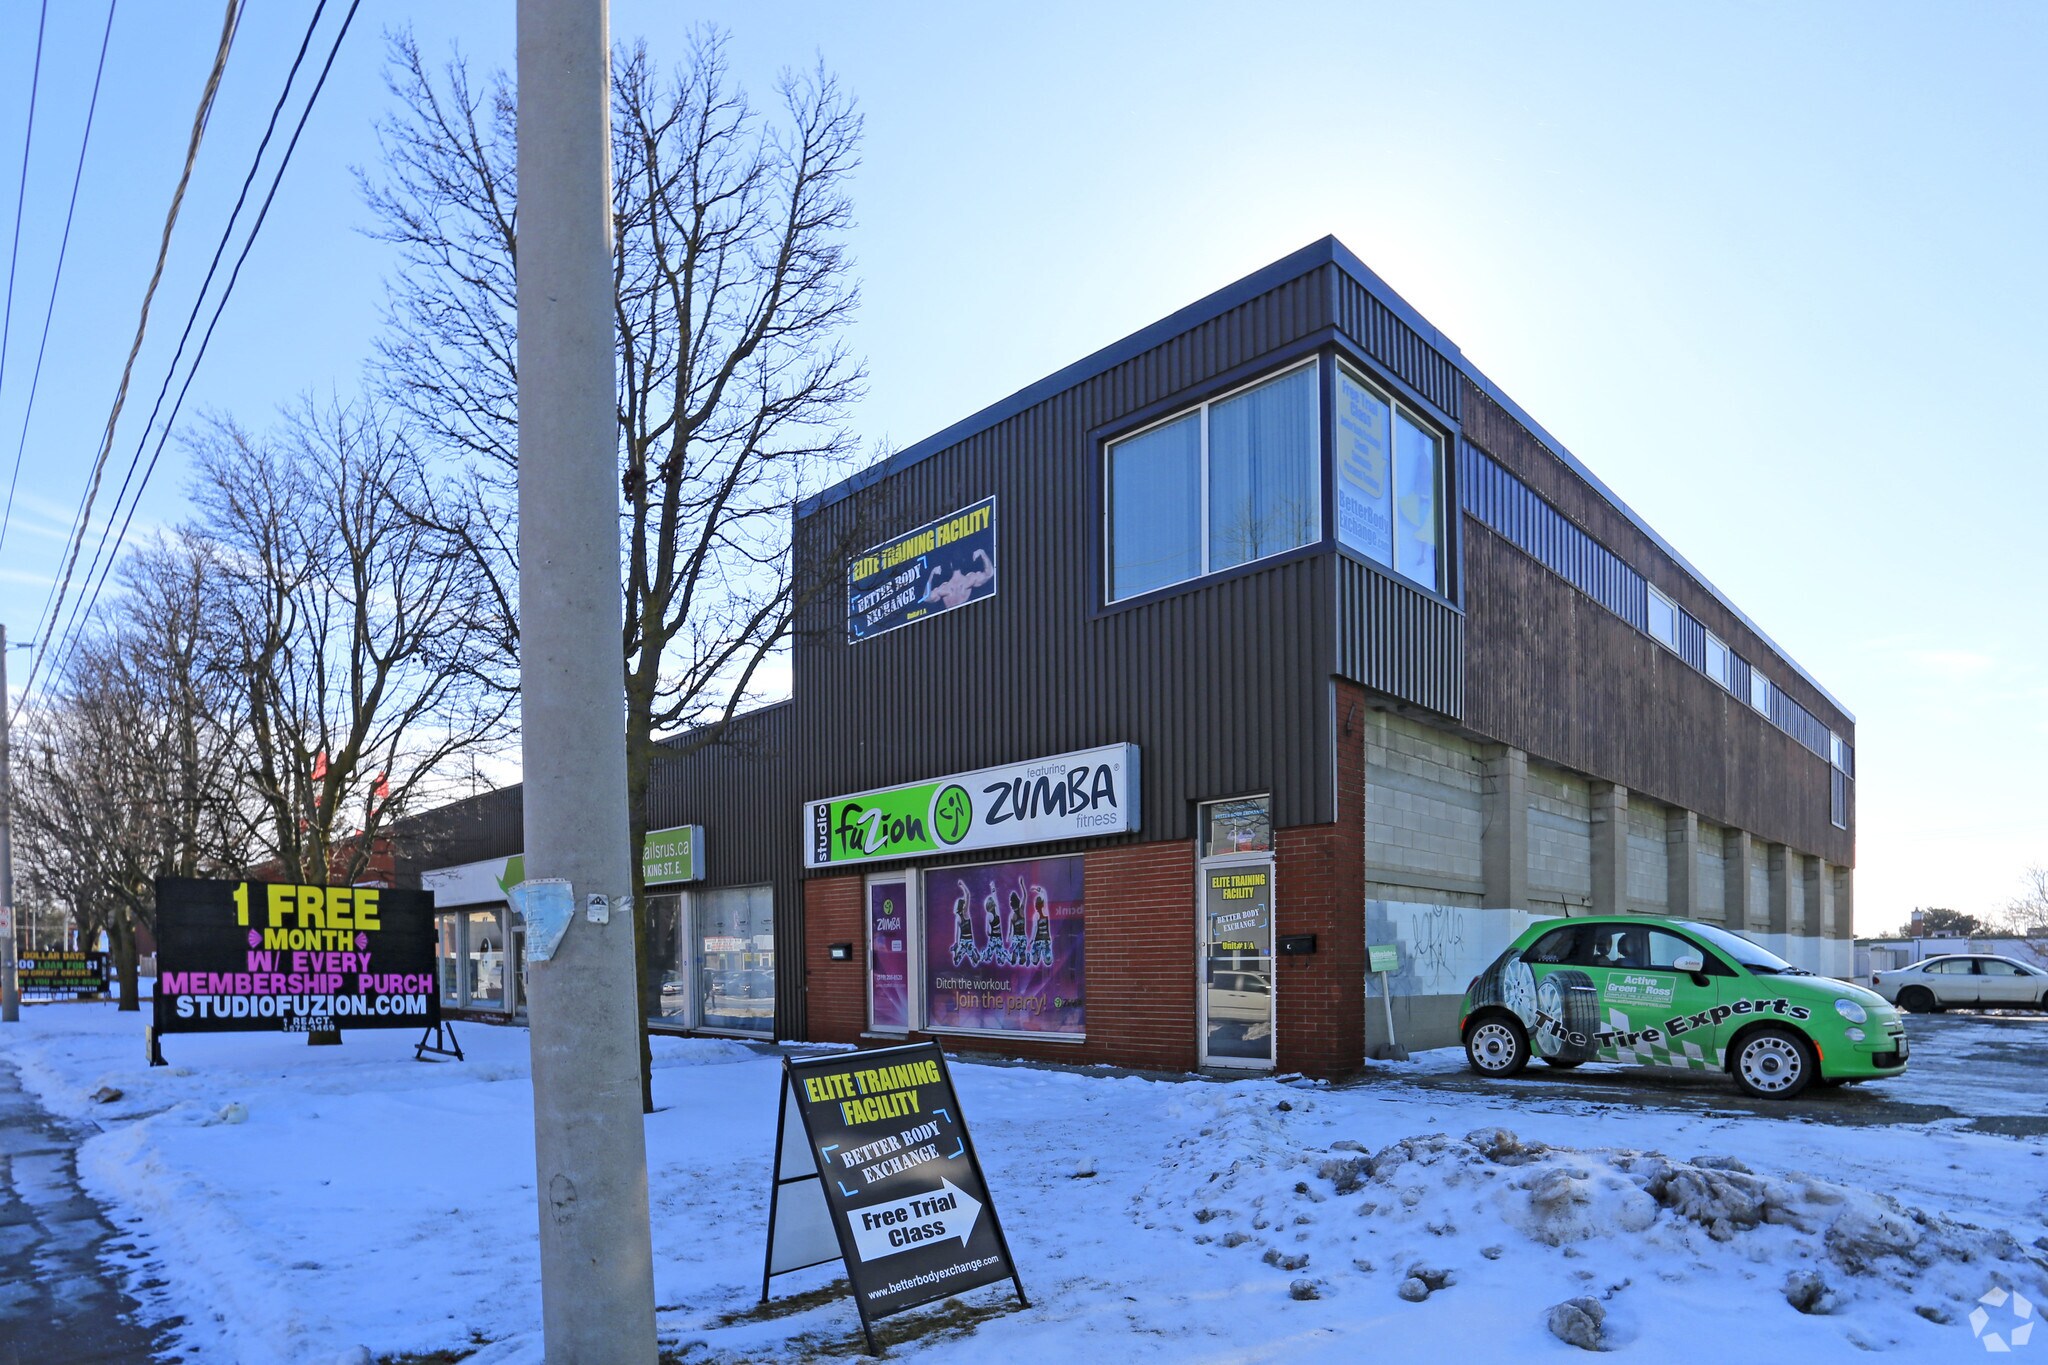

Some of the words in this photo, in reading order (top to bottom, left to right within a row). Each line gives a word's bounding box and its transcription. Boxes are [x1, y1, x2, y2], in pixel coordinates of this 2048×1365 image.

[1339, 489, 1390, 535] BetterBody
[853, 556, 880, 582] ELITE
[881, 530, 934, 570] TRAINING
[935, 505, 990, 548] FACILITY
[858, 580, 893, 613] BETTER
[895, 563, 921, 591] BODY
[866, 587, 916, 627] EXCHANGE
[1027, 763, 1066, 778] featuring
[983, 763, 1117, 825] ZUMBA
[1076, 811, 1117, 829] fitness
[817, 804, 828, 862] studio
[643, 841, 689, 861] ailsrus.ca
[647, 863, 662, 877] KING
[664, 862, 673, 876] ST.
[675, 861, 682, 874] E.
[1212, 875, 1230, 889] ELITE
[1231, 873, 1266, 888] TRAINING
[1222, 886, 1254, 900] FACILITY
[233, 883, 249, 926] 1
[267, 884, 381, 930] FREE
[1217, 911, 1242, 925] BETTER
[1242, 908, 1259, 921] BODY
[877, 917, 901, 931] ZUMBA
[1223, 919, 1256, 932] EXCHANGE
[264, 928, 353, 951] MONTH
[23, 952, 60, 960] DOLLAR
[63, 952, 85, 960] DAYS
[38, 961, 63, 969] LOAN
[66, 961, 85, 970] FOR
[86, 960, 98, 970] $1
[248, 951, 280, 972] W/
[292, 952, 371, 973] EVERY
[162, 972, 343, 995] MEMBERSHIP
[359, 974, 433, 994] PURCH
[936, 977, 956, 990] Ditch
[958, 978, 972, 990] the
[974, 978, 1011, 992] workout,
[1608, 983, 1637, 993] Green
[1645, 985, 1671, 996] Ross
[1624, 975, 1657, 986] Active
[176, 995, 427, 1018] STUDIOFUZION.COM
[981, 991, 1004, 1009] the
[1007, 993, 1047, 1015] party!
[1533, 1008, 1586, 1047] The
[1595, 1026, 1660, 1049] Tire
[1664, 997, 1812, 1037] Experts
[803, 1072, 856, 1103] ELITE
[855, 1060, 941, 1095] TRAINING
[839, 1090, 921, 1126] FACILITY
[840, 1135, 902, 1169] BETTER
[901, 1120, 941, 1147] BODY
[861, 1143, 940, 1184] EXCHANGE
[861, 1207, 908, 1231] Free
[909, 1192, 957, 1218] Trial
[888, 1220, 946, 1248] Class
[868, 1255, 999, 1300] www.betterbodyexchange.com
